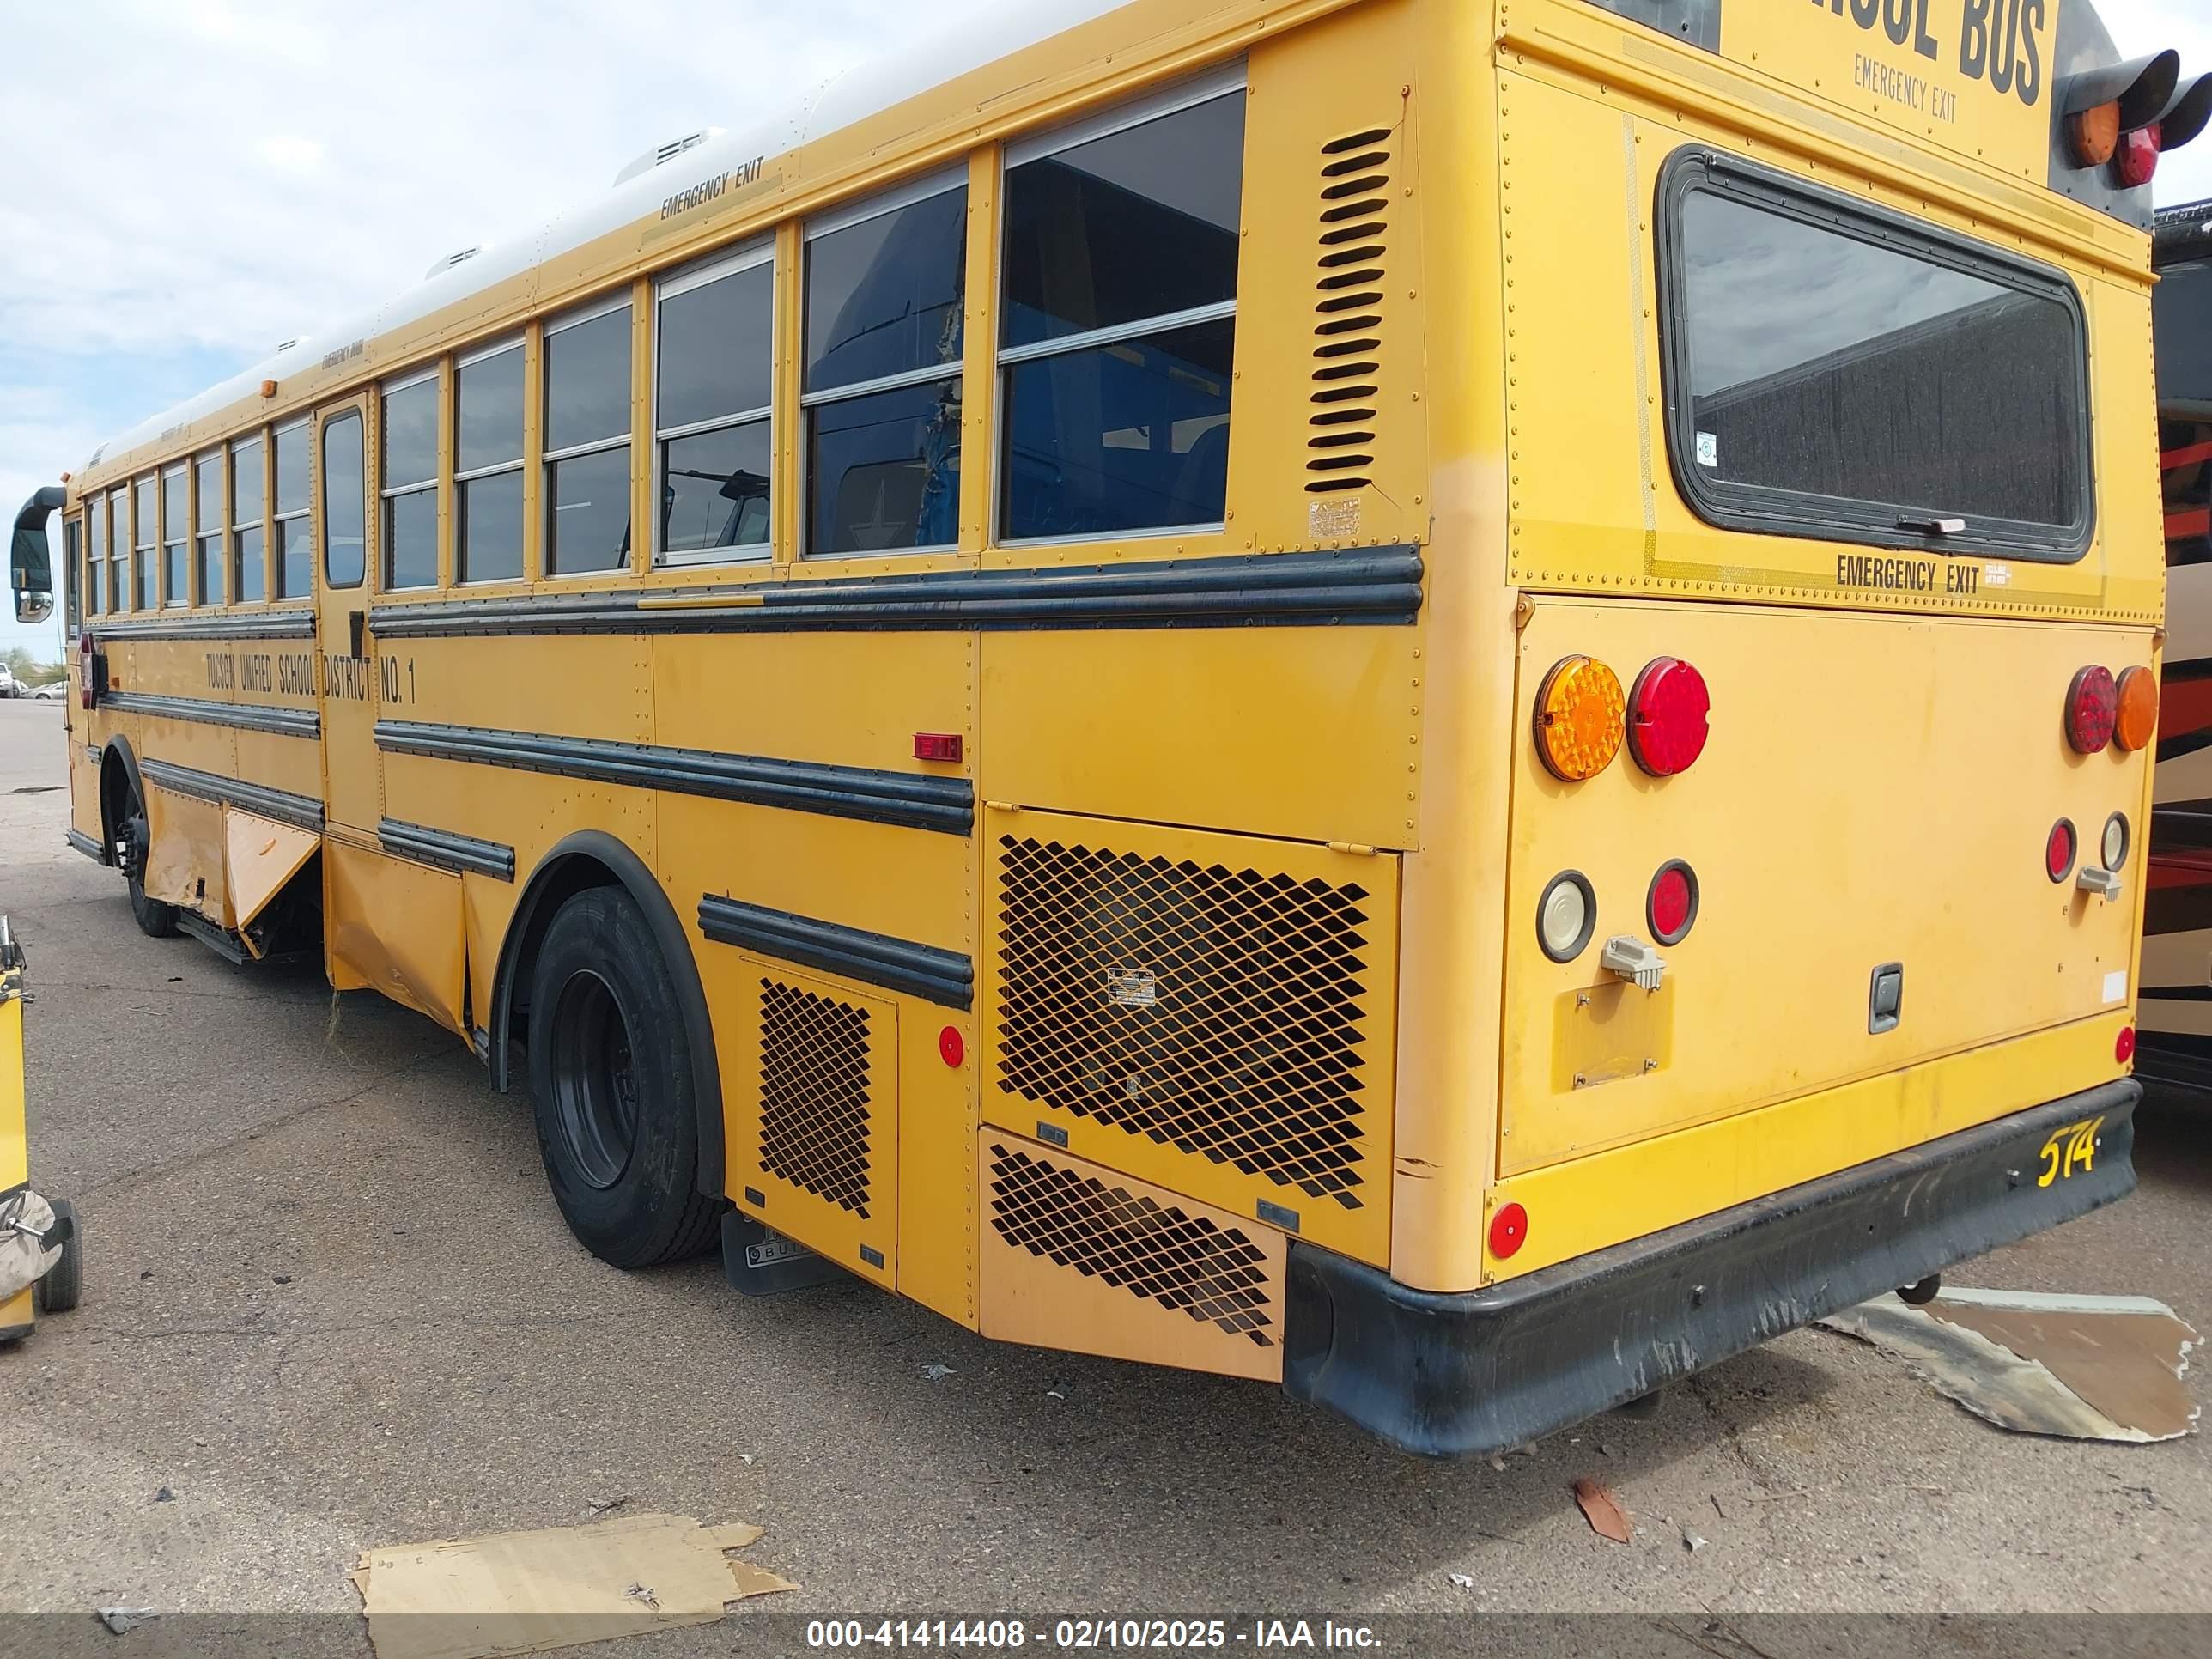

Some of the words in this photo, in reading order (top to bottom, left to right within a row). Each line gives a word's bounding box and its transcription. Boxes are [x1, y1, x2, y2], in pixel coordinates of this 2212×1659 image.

[1959, 0, 2045, 106] BUS
[1854, 52, 1928, 112] EMERGENCY
[1932, 87, 1957, 124] EXIT
[660, 171, 730, 221] EMERGENCY
[735, 155, 764, 189] EXIT
[1837, 554, 1936, 592] EMERGENCY
[1946, 563, 1979, 594] EXIT
[206, 653, 235, 690] TUCSON
[240, 653, 272, 693] UNIFIED
[278, 654, 316, 696] SCHOOL
[323, 654, 371, 702] DISTRICT
[380, 656, 402, 703] NO.
[408, 657, 415, 704] 1
[2037, 1115, 2105, 1188] 574
